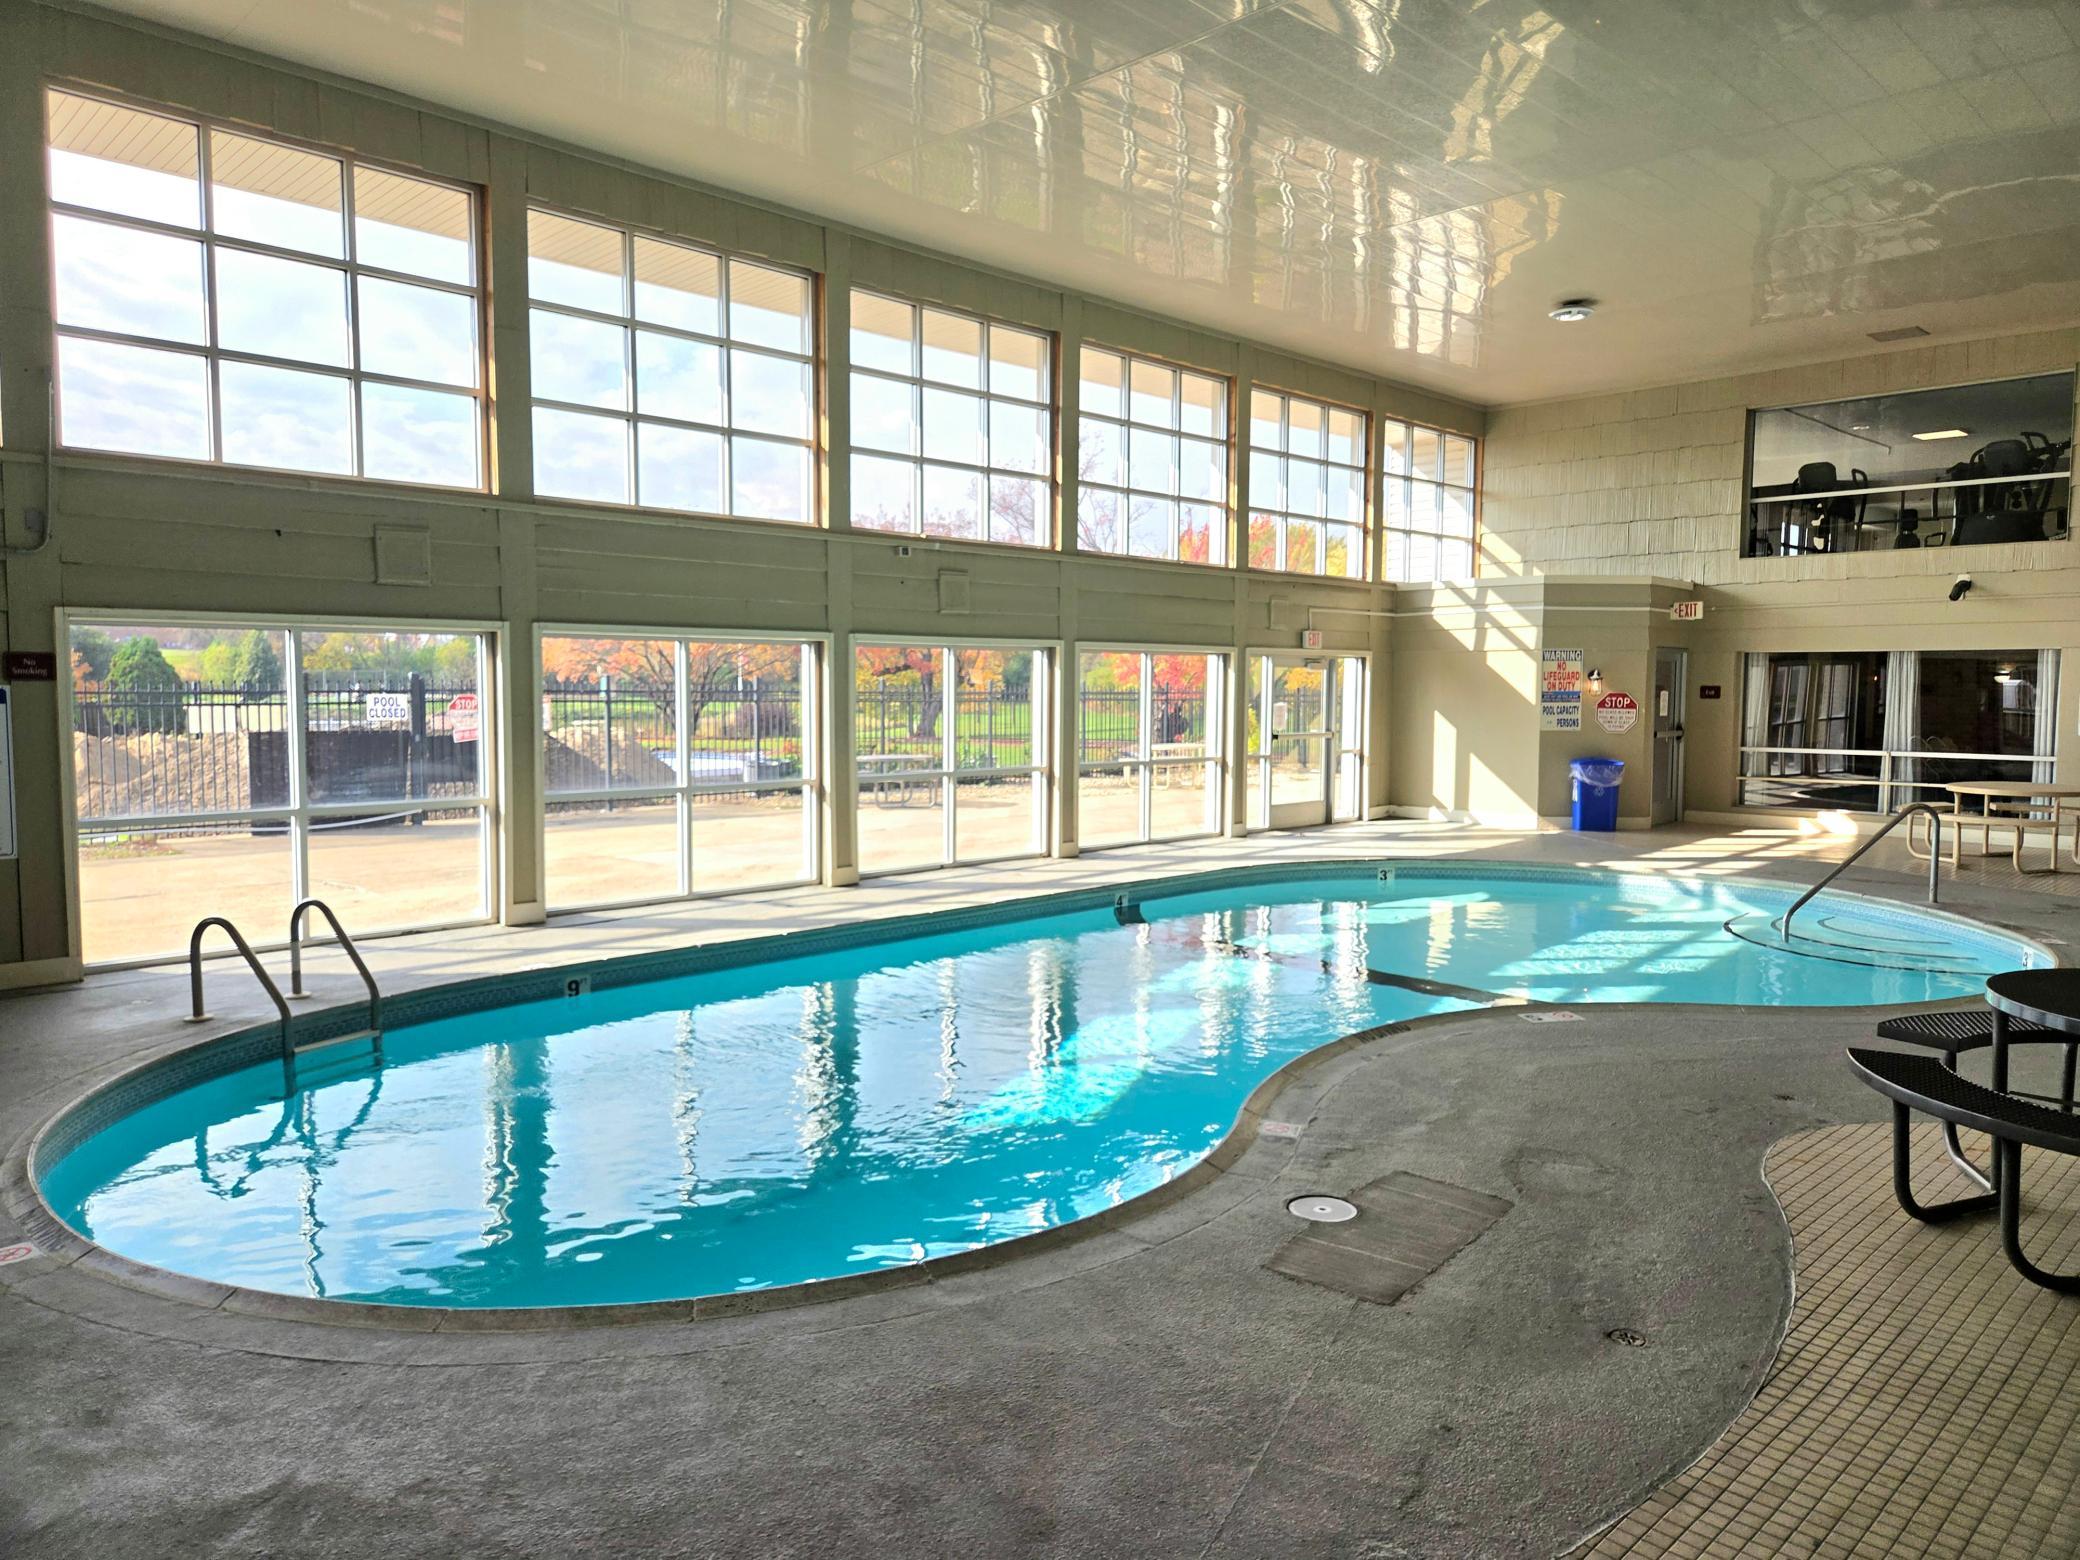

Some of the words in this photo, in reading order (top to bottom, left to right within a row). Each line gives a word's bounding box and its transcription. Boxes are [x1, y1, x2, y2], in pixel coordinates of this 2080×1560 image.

[1678, 603, 1698, 618] EXIT
[1308, 632, 1320, 647] EXIT
[1543, 650, 1582, 661] WARNING
[1557, 661, 1567, 671] NO
[12, 666, 48, 678] Smoking
[1543, 671, 1580, 681] LIFEGUARD
[1547, 681, 1557, 691] ON
[1558, 681, 1576, 691] DUTY
[373, 696, 401, 707] POOL
[1604, 697, 1631, 708] STOP
[368, 708, 406, 718] CLOSED
[1542, 705, 1556, 715] POOL
[1556, 705, 1580, 715] CAPACITY
[1556, 718, 1579, 728] PERSONS
[1379, 869, 1388, 881] 3
[1116, 895, 1123, 906] 4
[567, 979, 580, 997] 9
